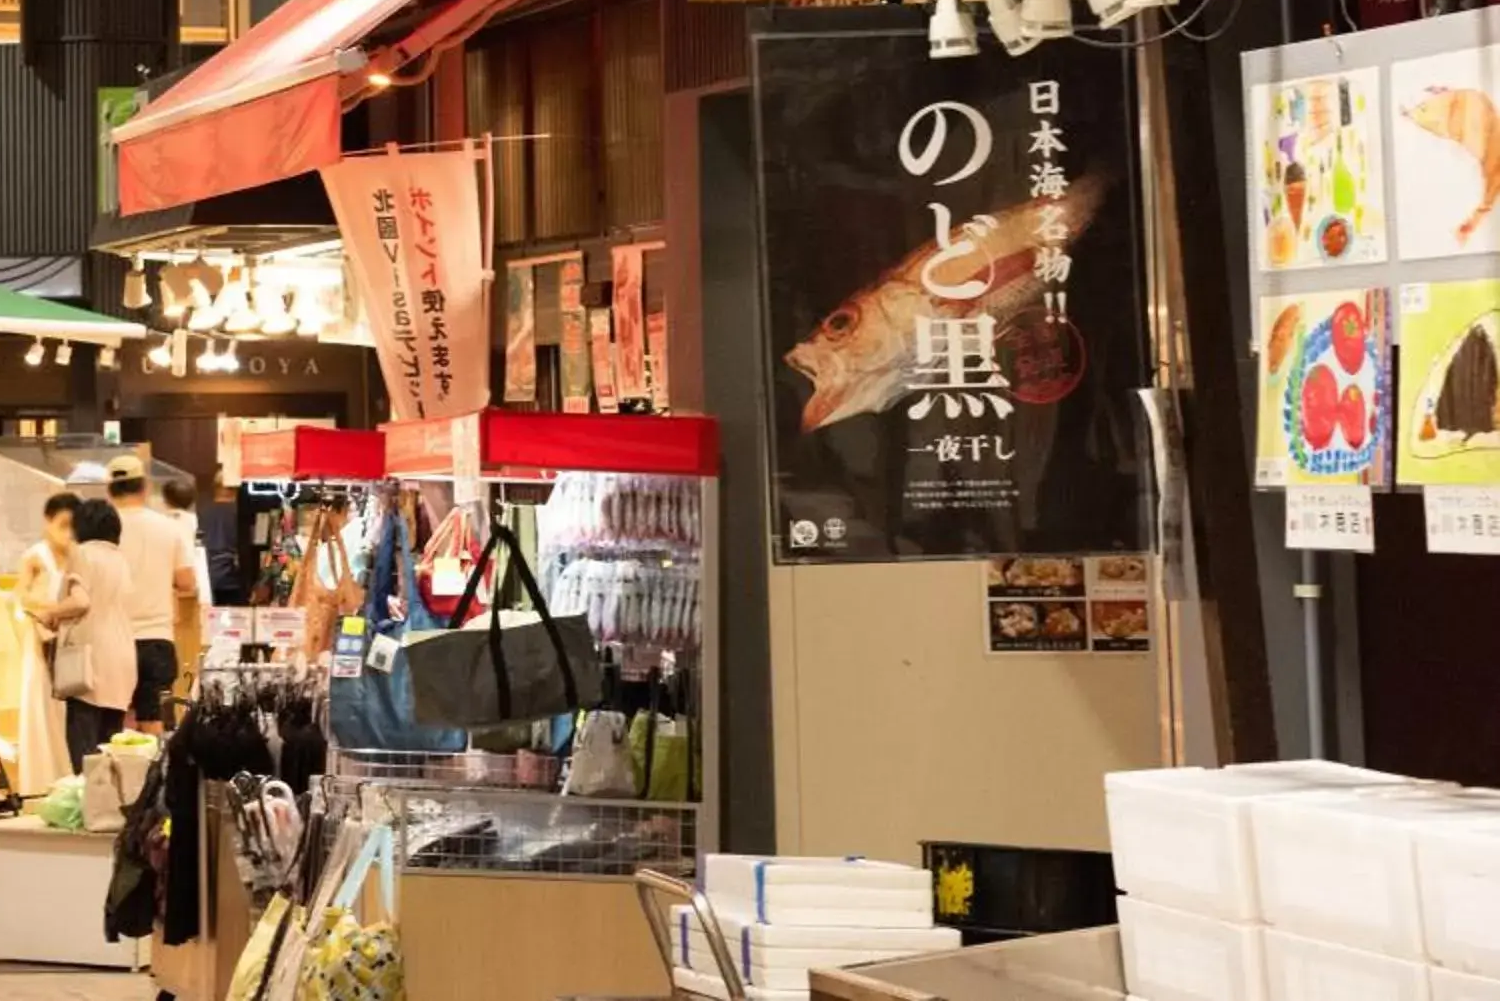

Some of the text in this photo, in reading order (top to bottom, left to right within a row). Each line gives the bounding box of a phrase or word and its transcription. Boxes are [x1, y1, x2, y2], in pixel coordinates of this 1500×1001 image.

[899, 101, 1015, 420] のど黒
[907, 435, 1016, 462] 一夜干し
